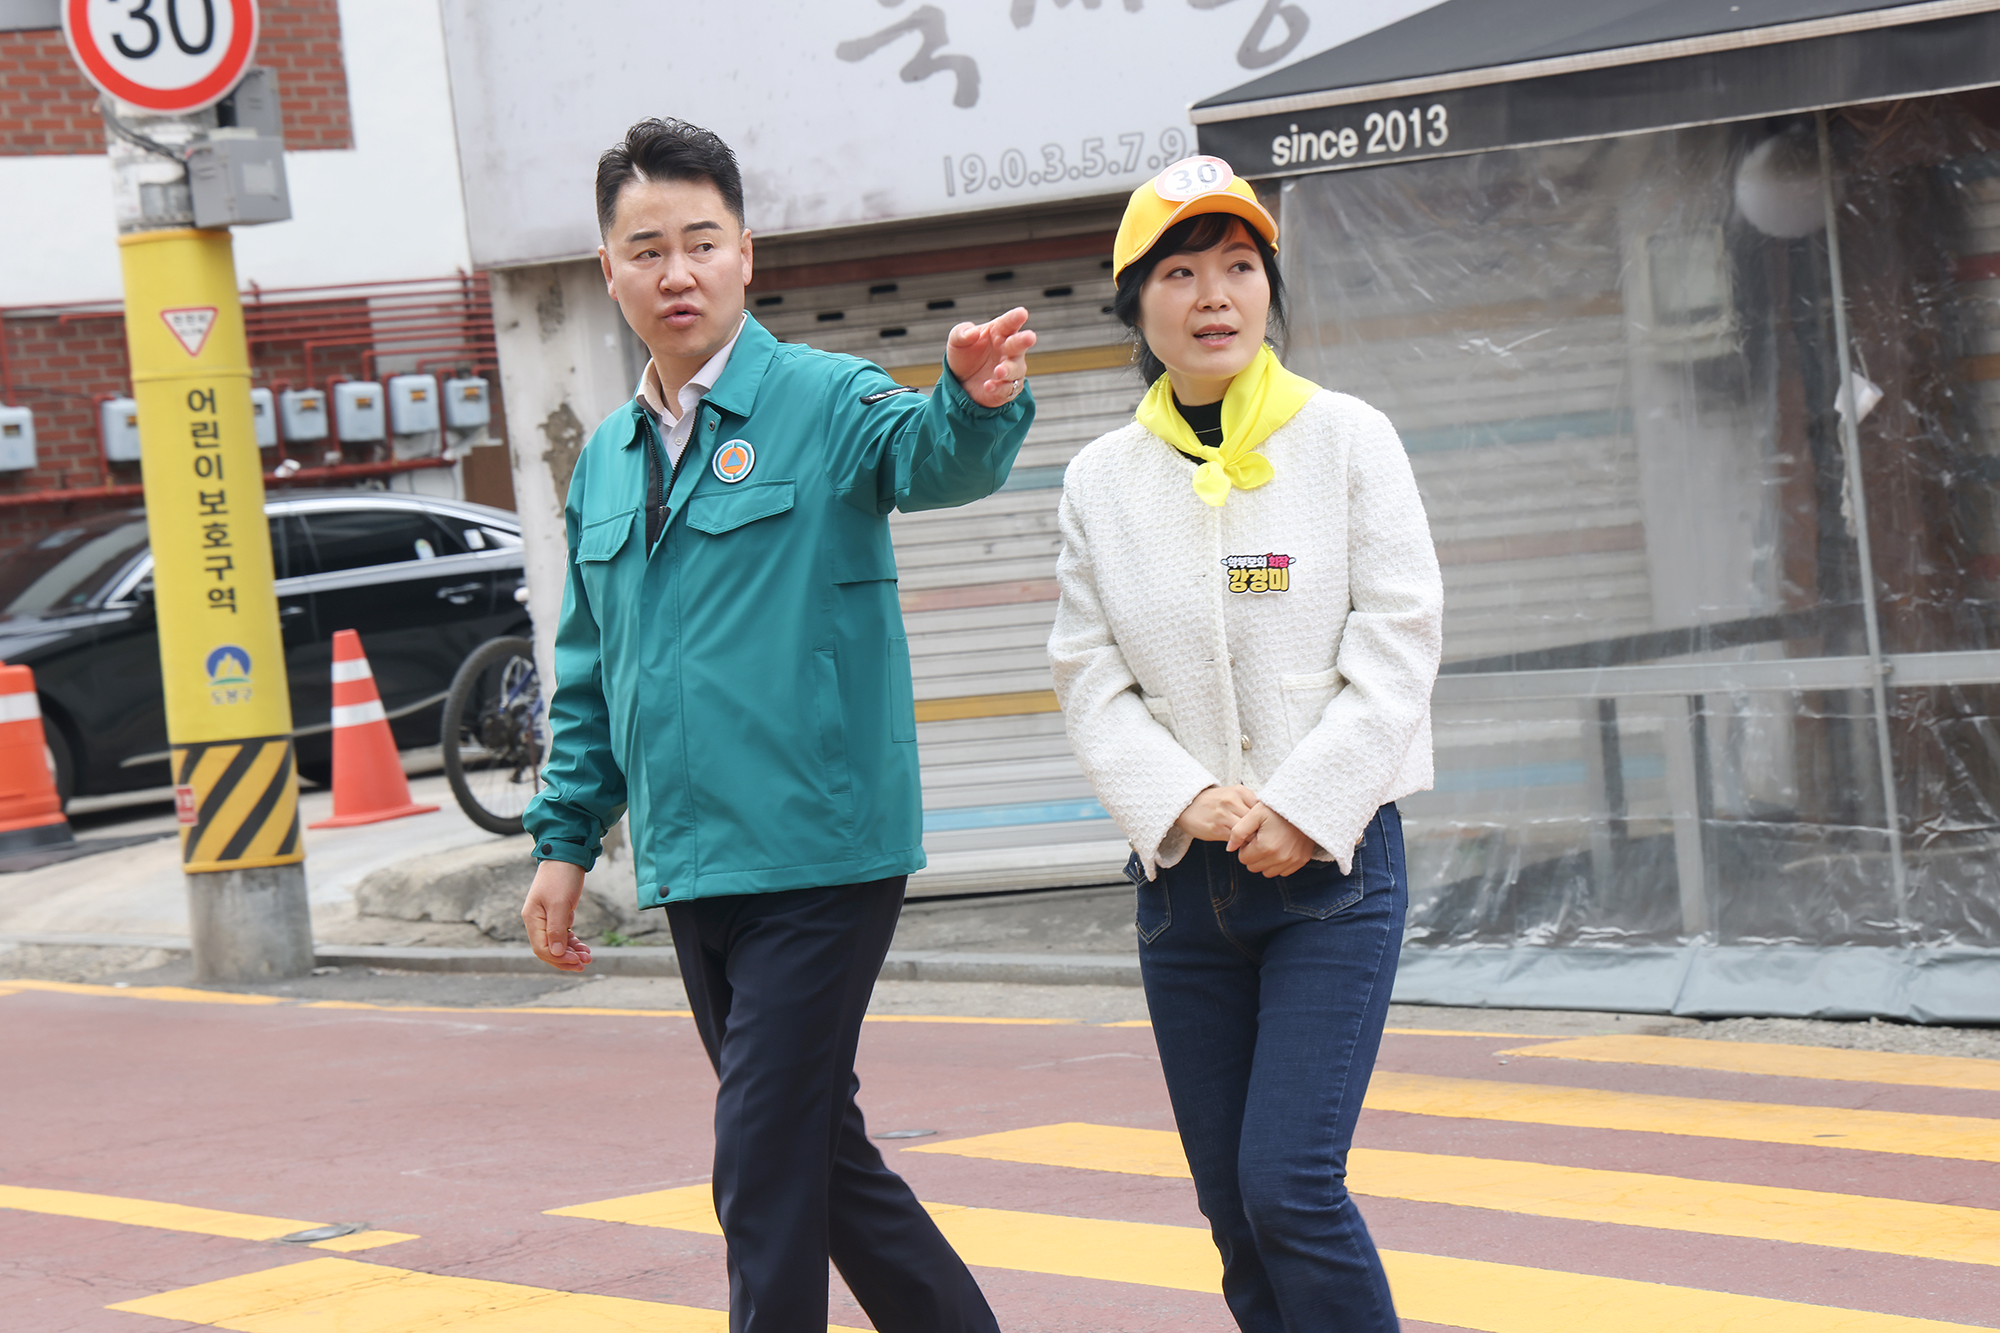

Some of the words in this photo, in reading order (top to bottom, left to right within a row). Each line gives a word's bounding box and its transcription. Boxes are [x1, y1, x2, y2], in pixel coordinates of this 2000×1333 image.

[112, 0, 215, 59] 30
[1272, 123, 1359, 166] since
[1364, 104, 1449, 154] 2013
[1172, 163, 1218, 191] 30
[187, 388, 237, 614] 어린이보호구역
[1227, 556, 1268, 569] 학부모회
[1228, 567, 1289, 593] 강경미
